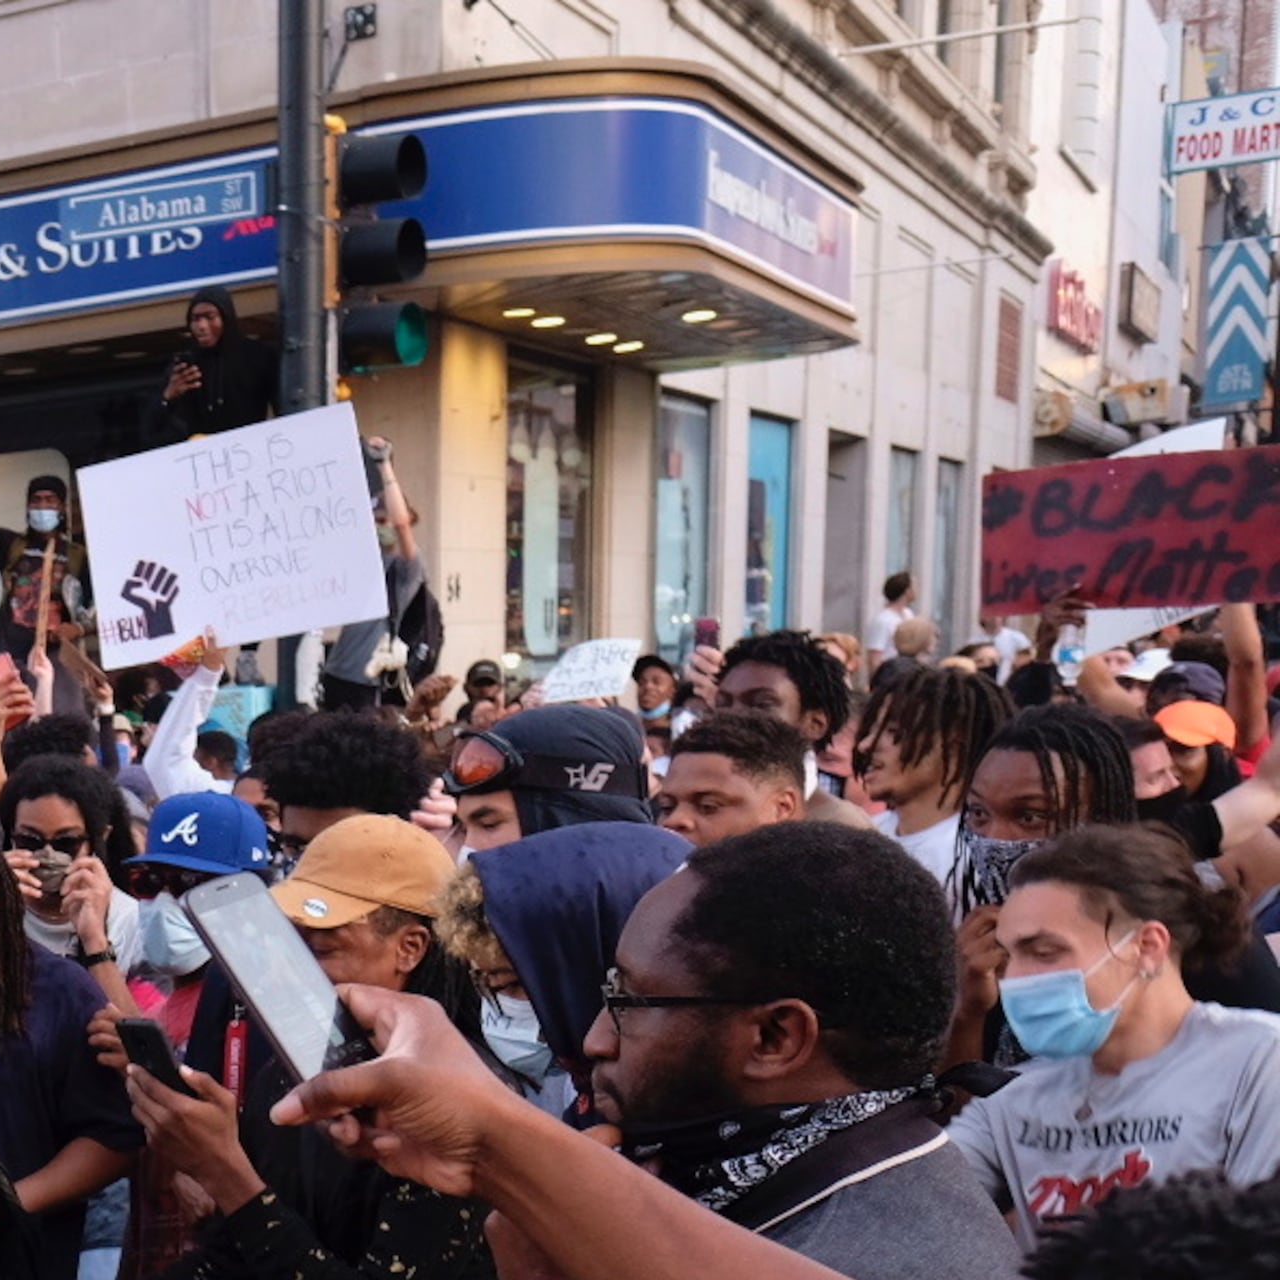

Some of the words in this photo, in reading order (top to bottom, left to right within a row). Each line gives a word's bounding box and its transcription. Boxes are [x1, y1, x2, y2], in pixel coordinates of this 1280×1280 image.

[1189, 105, 1210, 126] J
[1218, 107, 1241, 122] &
[1250, 96, 1276, 117] C
[1175, 130, 1223, 164] FOOD
[223, 178, 242, 195] ST
[98, 194, 208, 228] Alabama
[221, 197, 243, 213] SW
[266, 432, 294, 464] IS
[185, 481, 237, 526] NOT
[243, 480, 261, 515] A
[266, 459, 338, 503] RIOT
[188, 523, 220, 562] IT
[225, 518, 254, 556] IS
[160, 811, 200, 846] A
